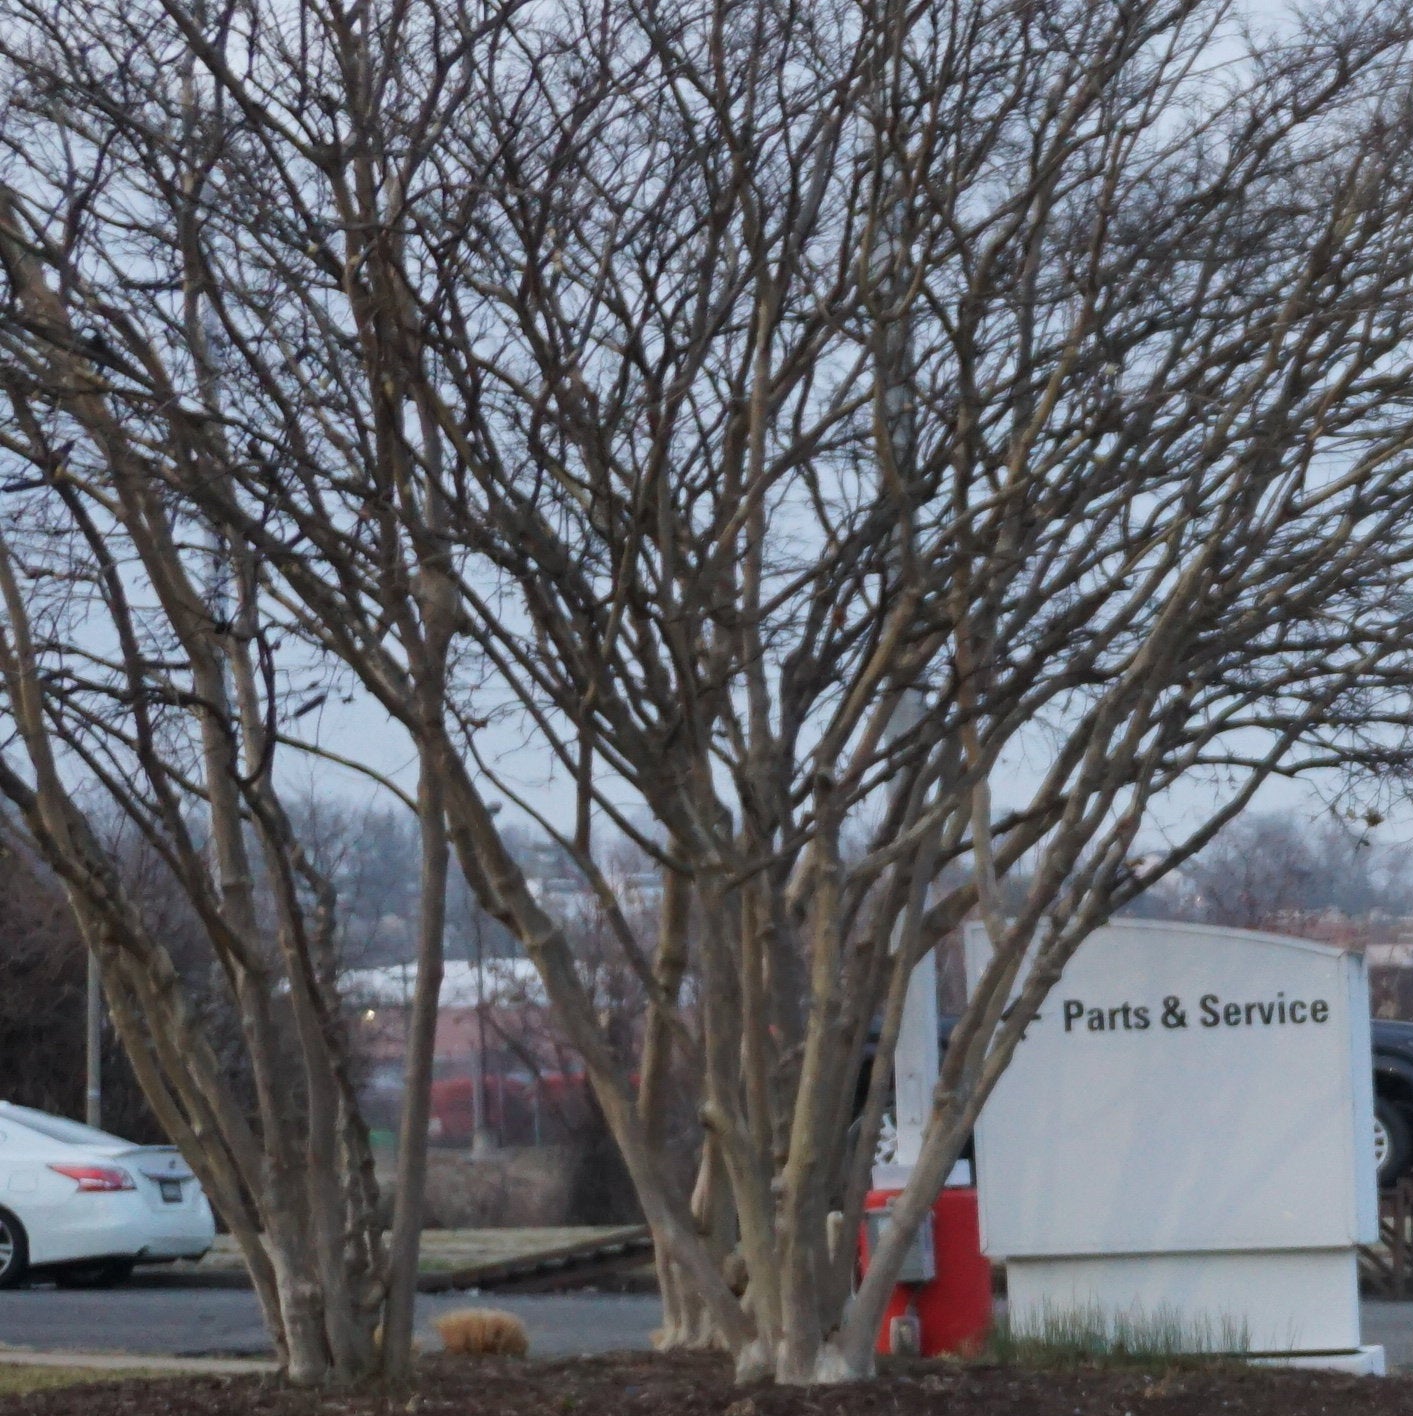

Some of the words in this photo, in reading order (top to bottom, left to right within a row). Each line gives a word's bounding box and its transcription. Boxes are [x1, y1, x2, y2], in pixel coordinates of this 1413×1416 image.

[1063, 999, 1150, 1032] Parts
[1160, 995, 1188, 1029] &
[1199, 991, 1330, 1028] Service
